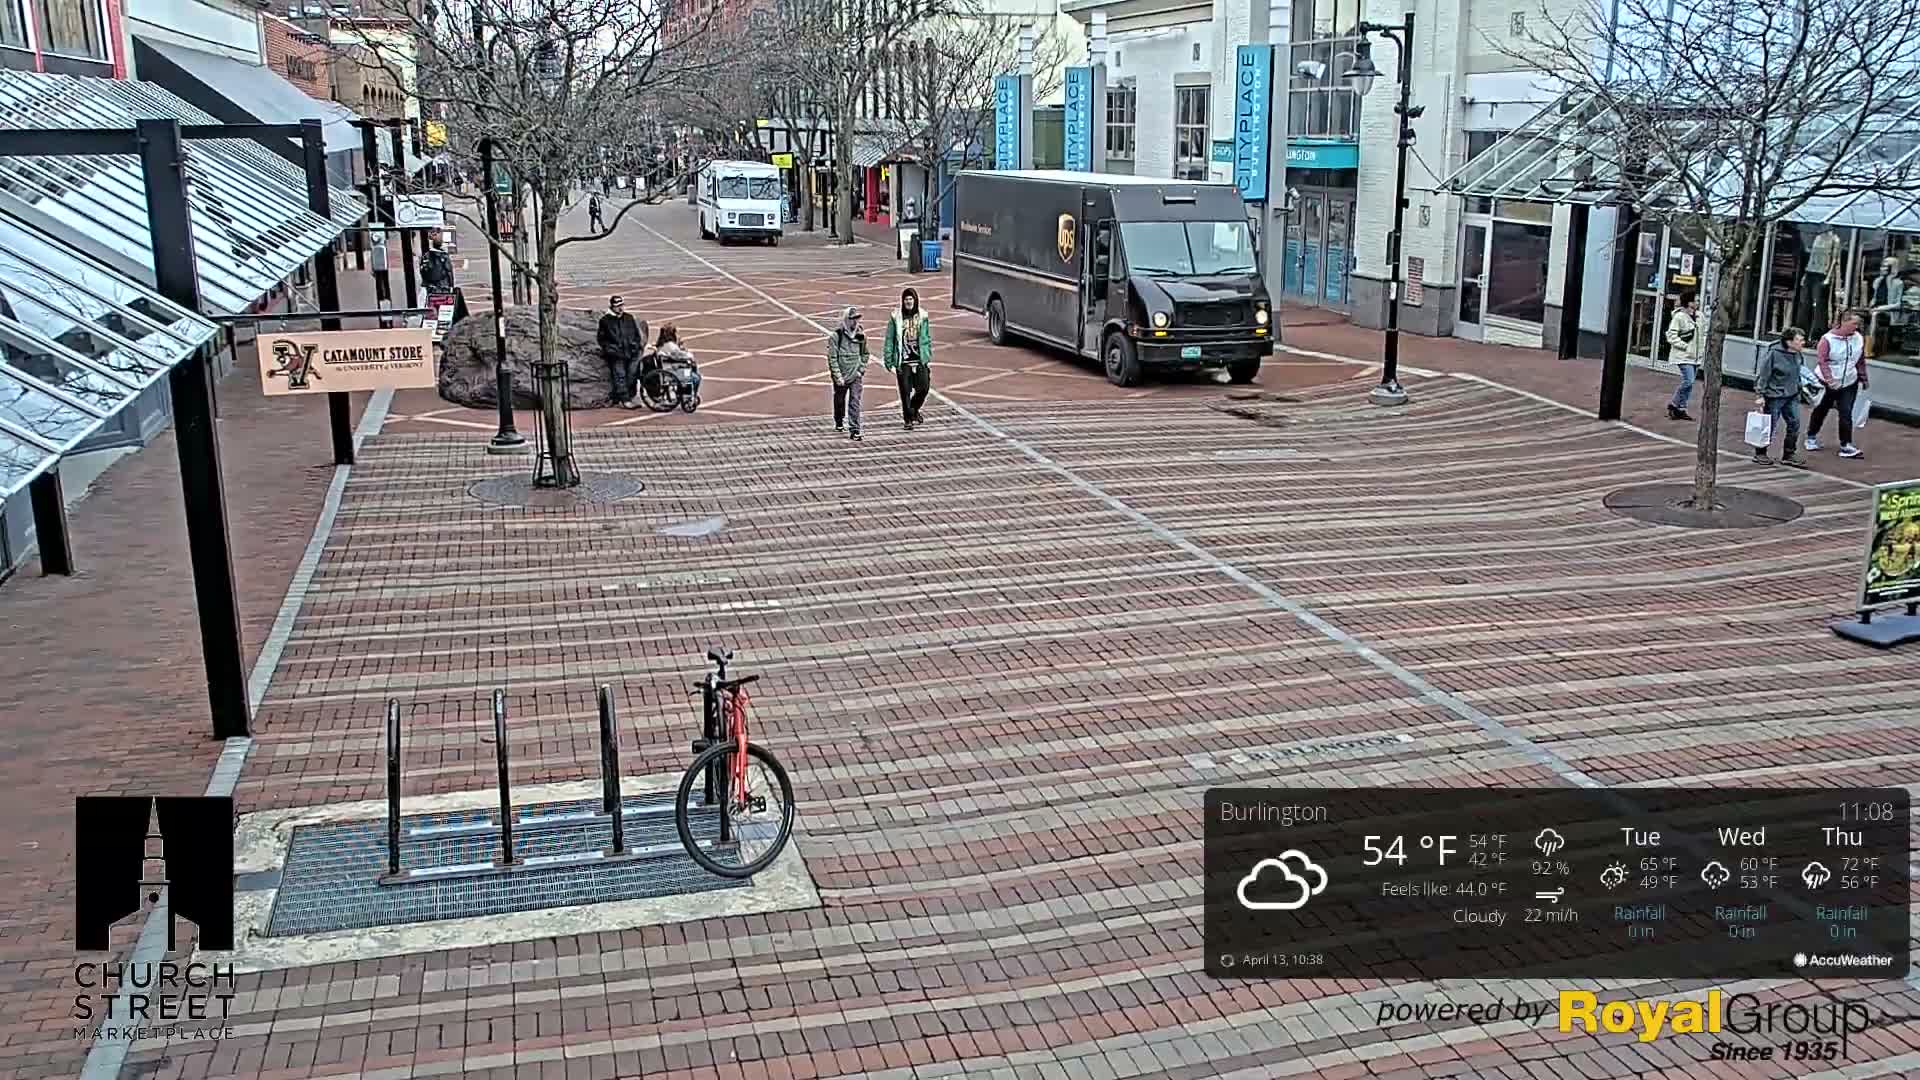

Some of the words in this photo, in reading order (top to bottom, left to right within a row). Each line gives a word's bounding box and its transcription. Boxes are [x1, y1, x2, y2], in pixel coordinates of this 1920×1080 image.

[1067, 72, 1079, 169] ITYPLACE
[1237, 53, 1255, 191] CITYPLACE
[1251, 68, 1262, 177] BURLINGTON
[1059, 229, 1074, 255] ups
[323, 347, 386, 362] CATAMOUNT
[388, 345, 423, 359] STORE
[1890, 492, 1920, 510] Sprin
